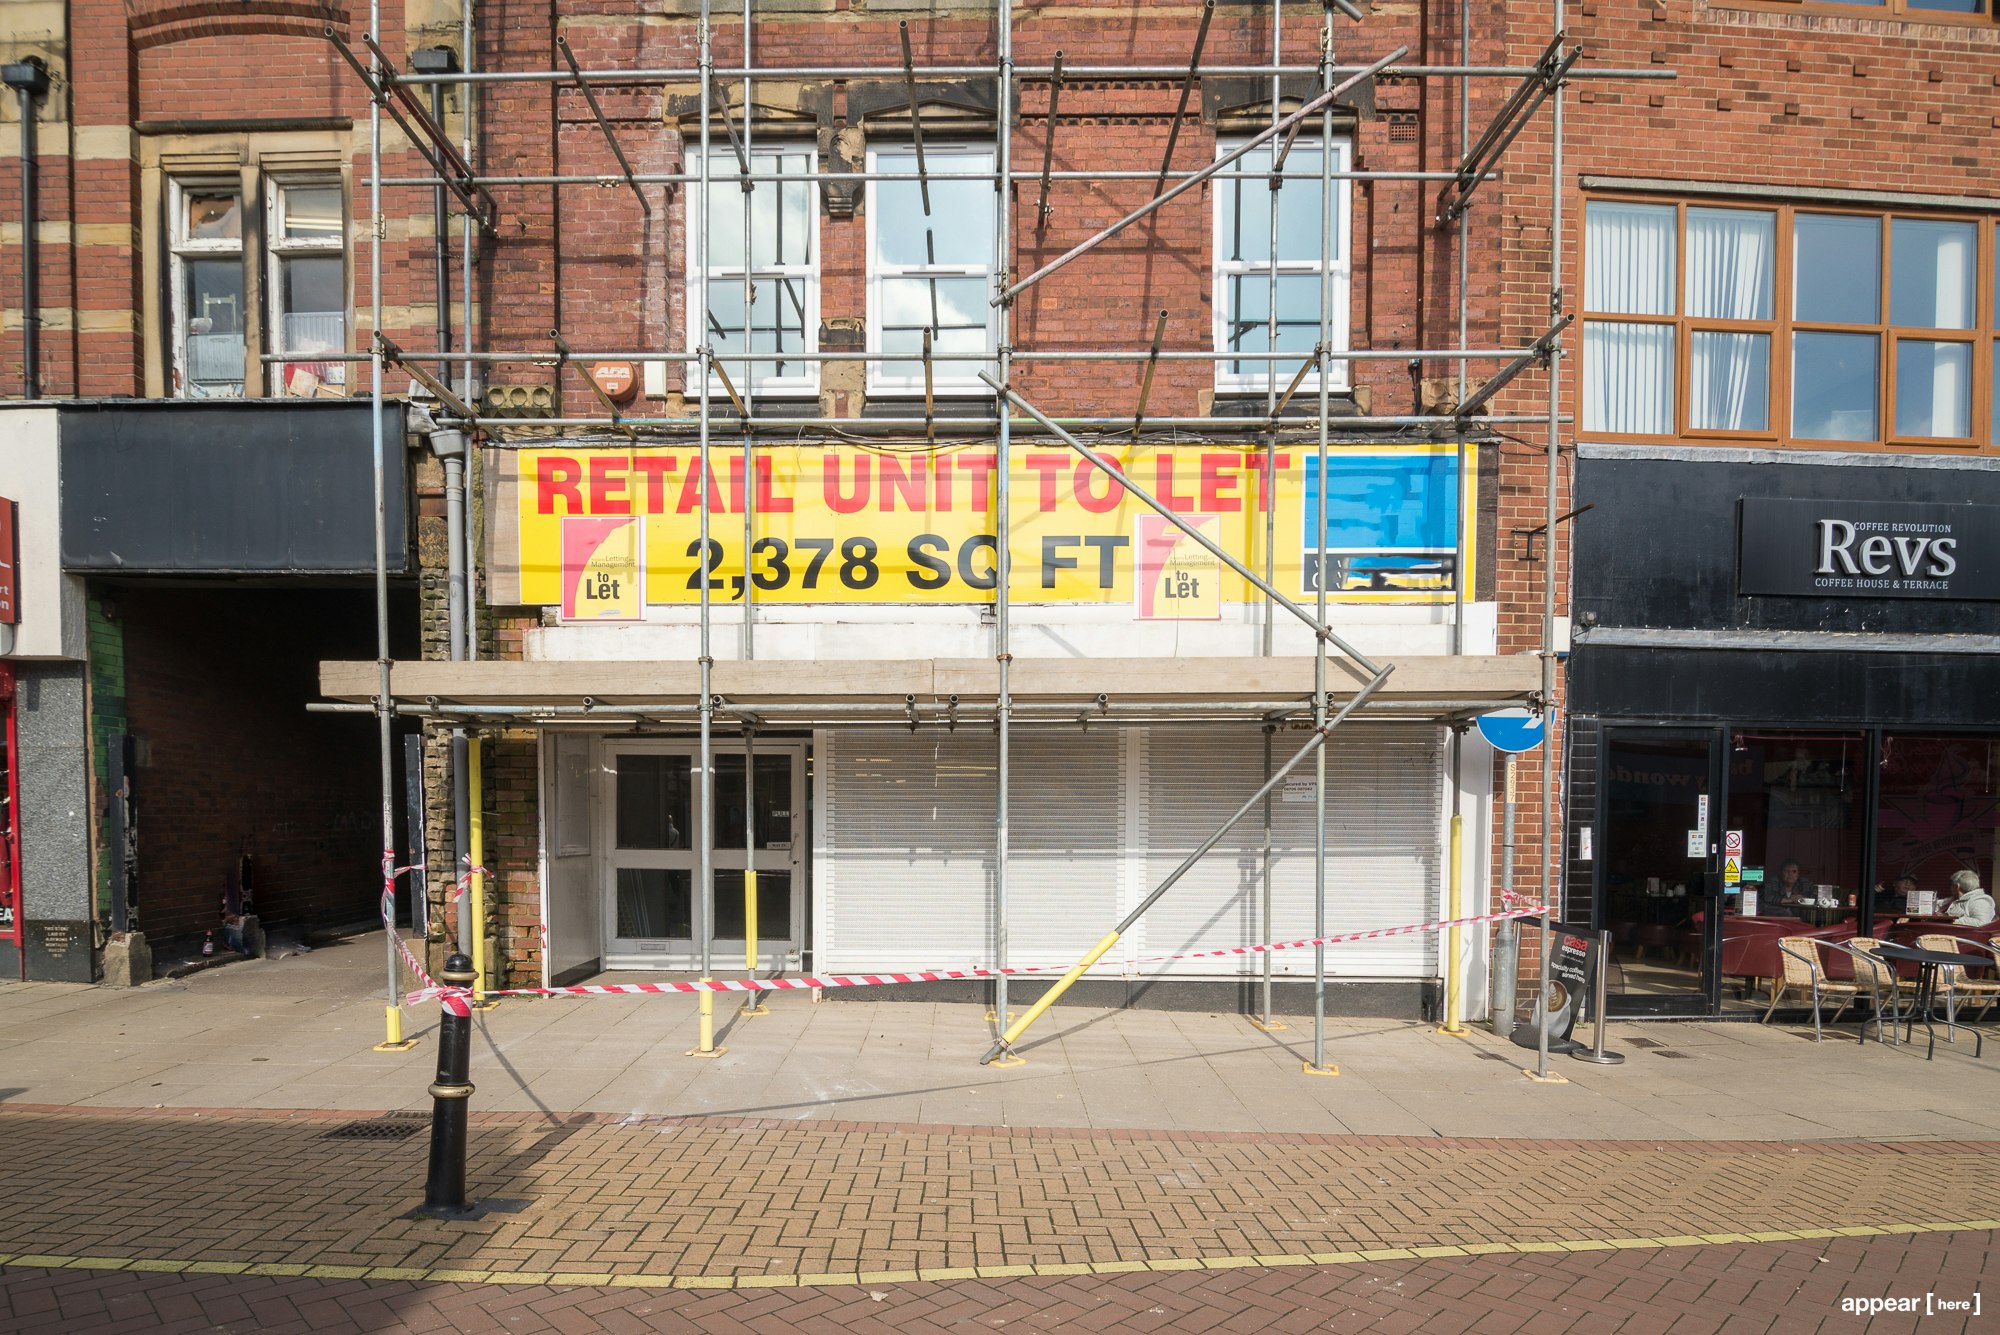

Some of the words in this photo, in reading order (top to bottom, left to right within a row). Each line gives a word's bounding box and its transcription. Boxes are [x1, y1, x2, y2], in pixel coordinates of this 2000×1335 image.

[537, 455, 794, 514] RETAIL
[823, 453, 997, 514] UNIT
[1026, 453, 1125, 513] TO
[1156, 453, 1290, 513] LET
[1854, 521, 1889, 532] COFFEE
[1892, 522, 1951, 533] REVOLUTION
[1814, 518, 1957, 577] Revs
[686, 536, 879, 600] 2,378
[905, 534, 1011, 590] SQ
[1041, 535, 1129, 589] FT
[597, 572, 609, 582] to
[1176, 570, 1188, 581] to
[586, 579, 620, 599] Let
[1165, 577, 1199, 599] Let
[1815, 577, 1854, 588] COFFEE
[1856, 578, 1890, 589] HOUSE
[1892, 580, 1900, 589] &
[1903, 580, 1949, 590] TERRACE
[1564, 935, 1588, 950] casa
[1561, 945, 1586, 958] espresso
